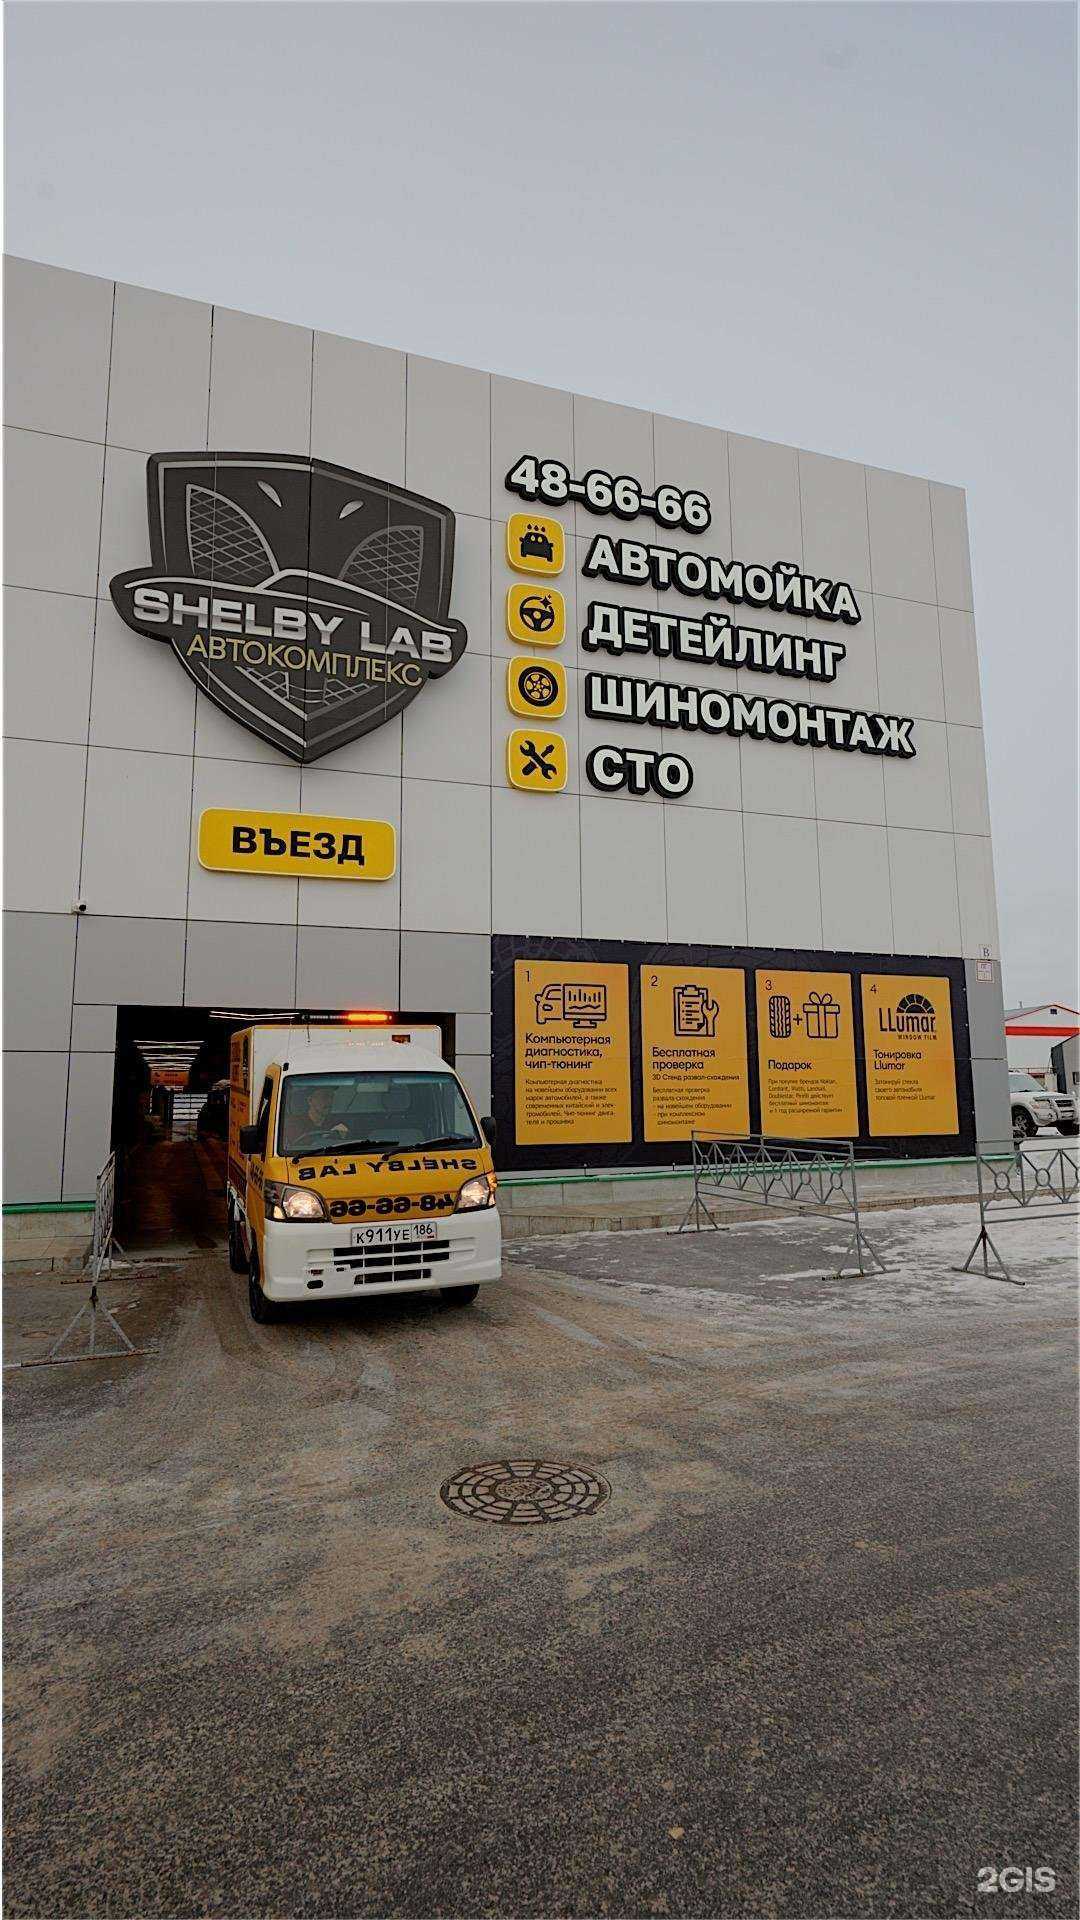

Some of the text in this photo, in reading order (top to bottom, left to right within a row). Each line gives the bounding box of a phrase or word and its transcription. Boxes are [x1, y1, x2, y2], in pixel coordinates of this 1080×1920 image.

[507, 456, 711, 531] 48-66-66
[585, 534, 861, 624] АВТОМОЙКА
[133, 588, 452, 664] SHELBY LAB
[584, 602, 845, 681] ДЕТЕЙЛИНГ
[187, 634, 422, 686] АВТОКОМПЛЕКС
[586, 673, 916, 757] ШИНОМОНТАЖ
[587, 744, 692, 797] СТО
[232, 826, 366, 866] ВЪЕЗД
[526, 970, 530, 982] 1
[651, 976, 658, 987] 2
[765, 980, 772, 990] 3
[870, 984, 878, 994] 4
[878, 1007, 936, 1032] LLumar
[525, 1034, 611, 1046] Компьютерная
[525, 1047, 603, 1058] диагностика,
[652, 1048, 716, 1059] Бесплатная
[874, 1050, 922, 1060] Тонировка
[525, 1060, 592, 1070] чип-тюнинг
[652, 1061, 704, 1072] проверка
[768, 1060, 812, 1072] Подарок
[662, 1074, 682, 1082] Стенд
[356, 1226, 410, 1244] К911УЕ
[414, 1224, 433, 1235] 186
